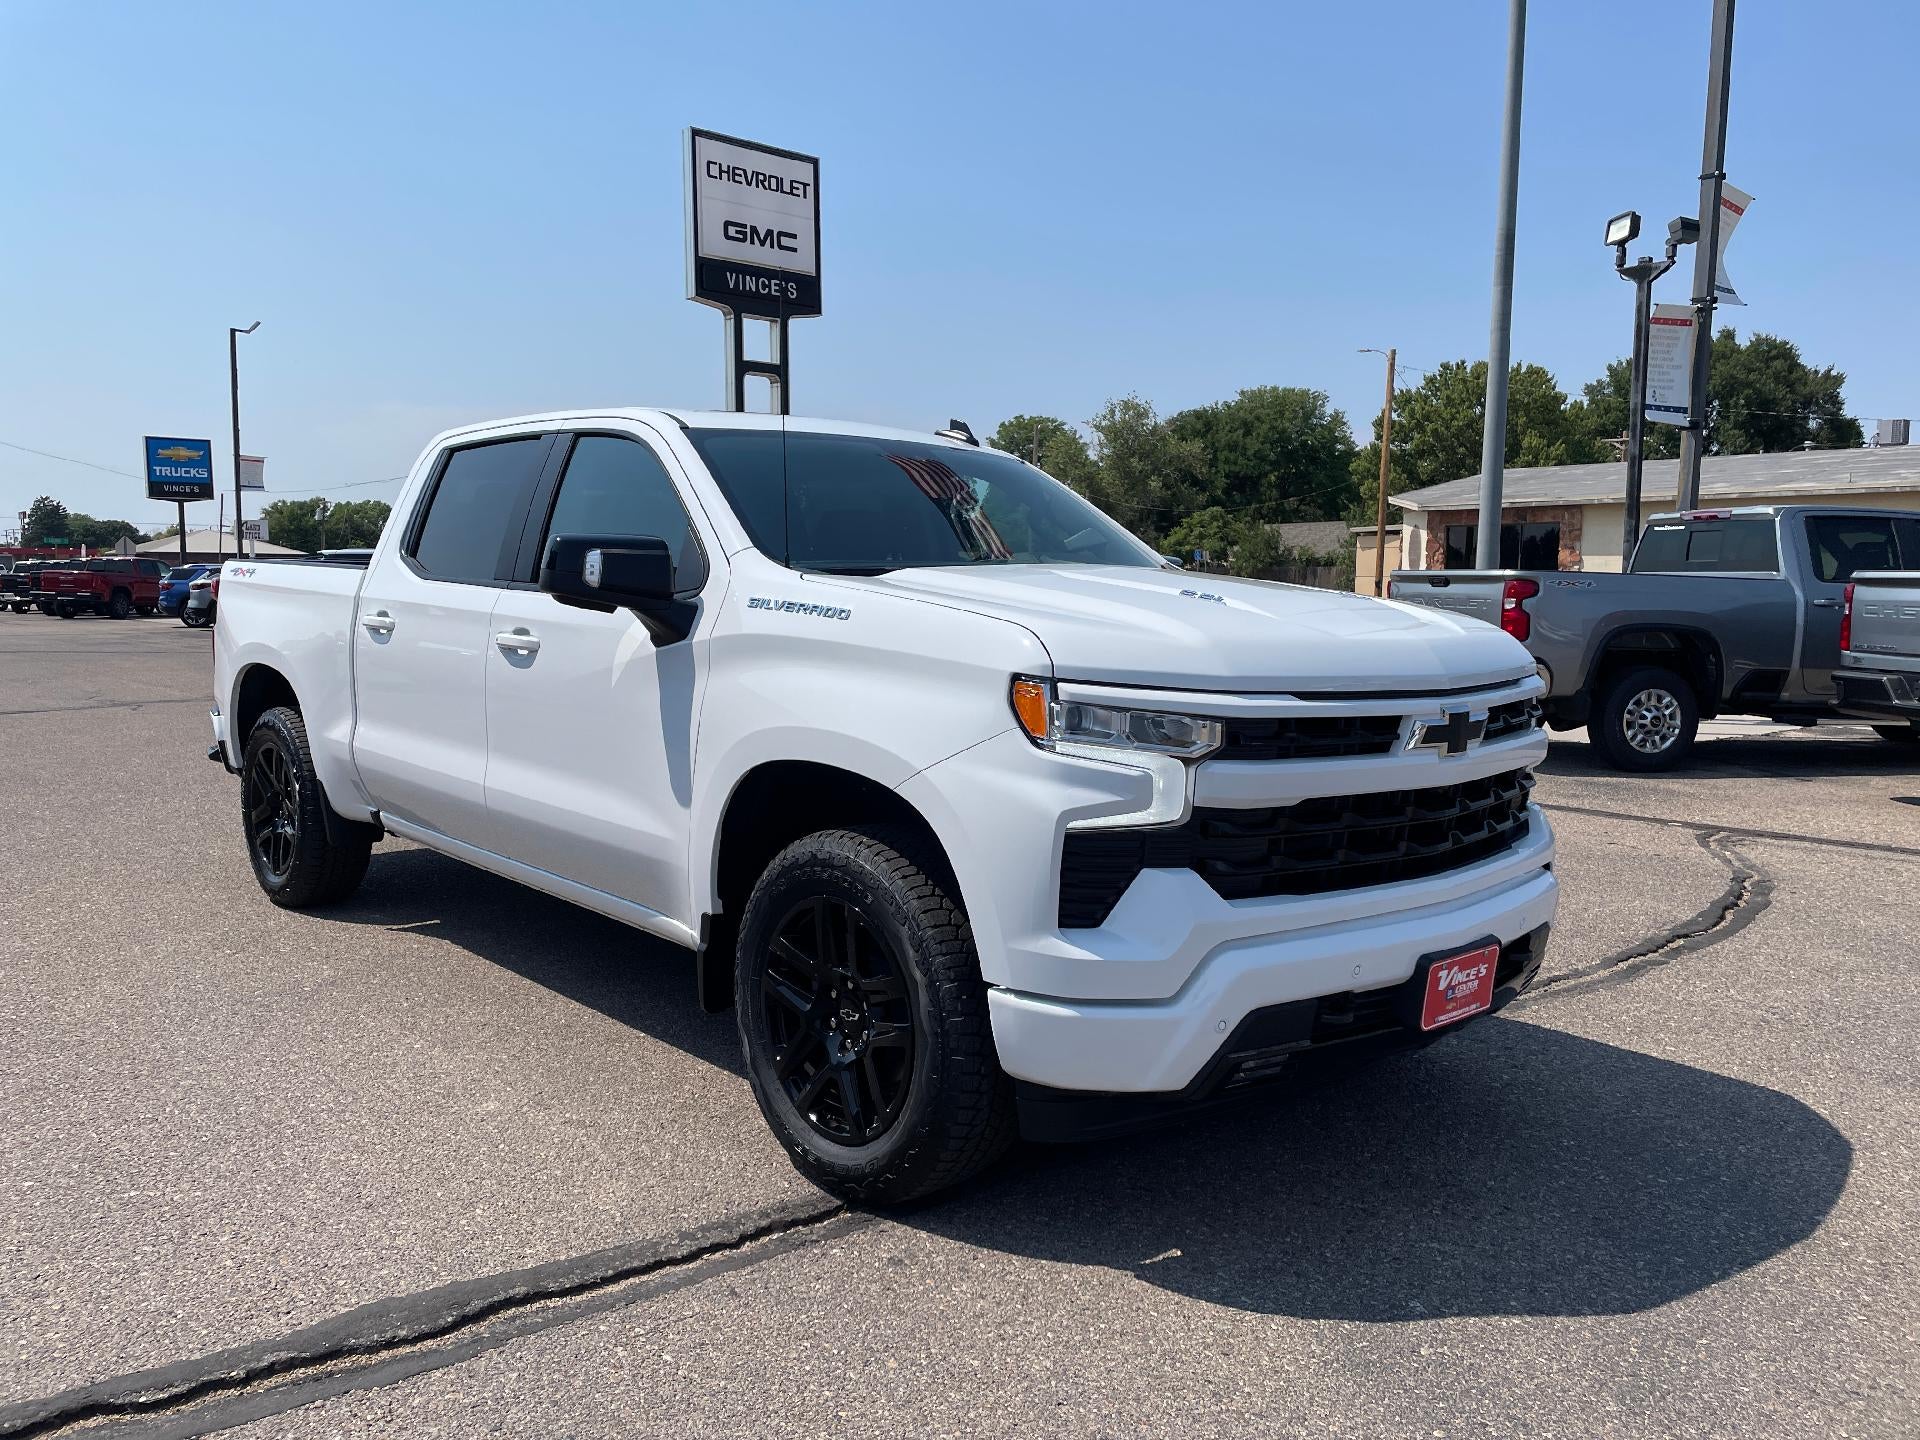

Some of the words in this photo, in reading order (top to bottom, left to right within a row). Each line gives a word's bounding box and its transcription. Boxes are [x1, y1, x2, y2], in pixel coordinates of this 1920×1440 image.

[706, 160, 810, 199] CHEVROLET
[723, 219, 798, 253] GMC
[726, 271, 797, 299] VINCE'S
[153, 466, 208, 478] TRUCKS
[163, 484, 200, 493] VINCE'S
[747, 597, 852, 621] SILVERADO
[1437, 963, 1488, 991] VINCE'S
